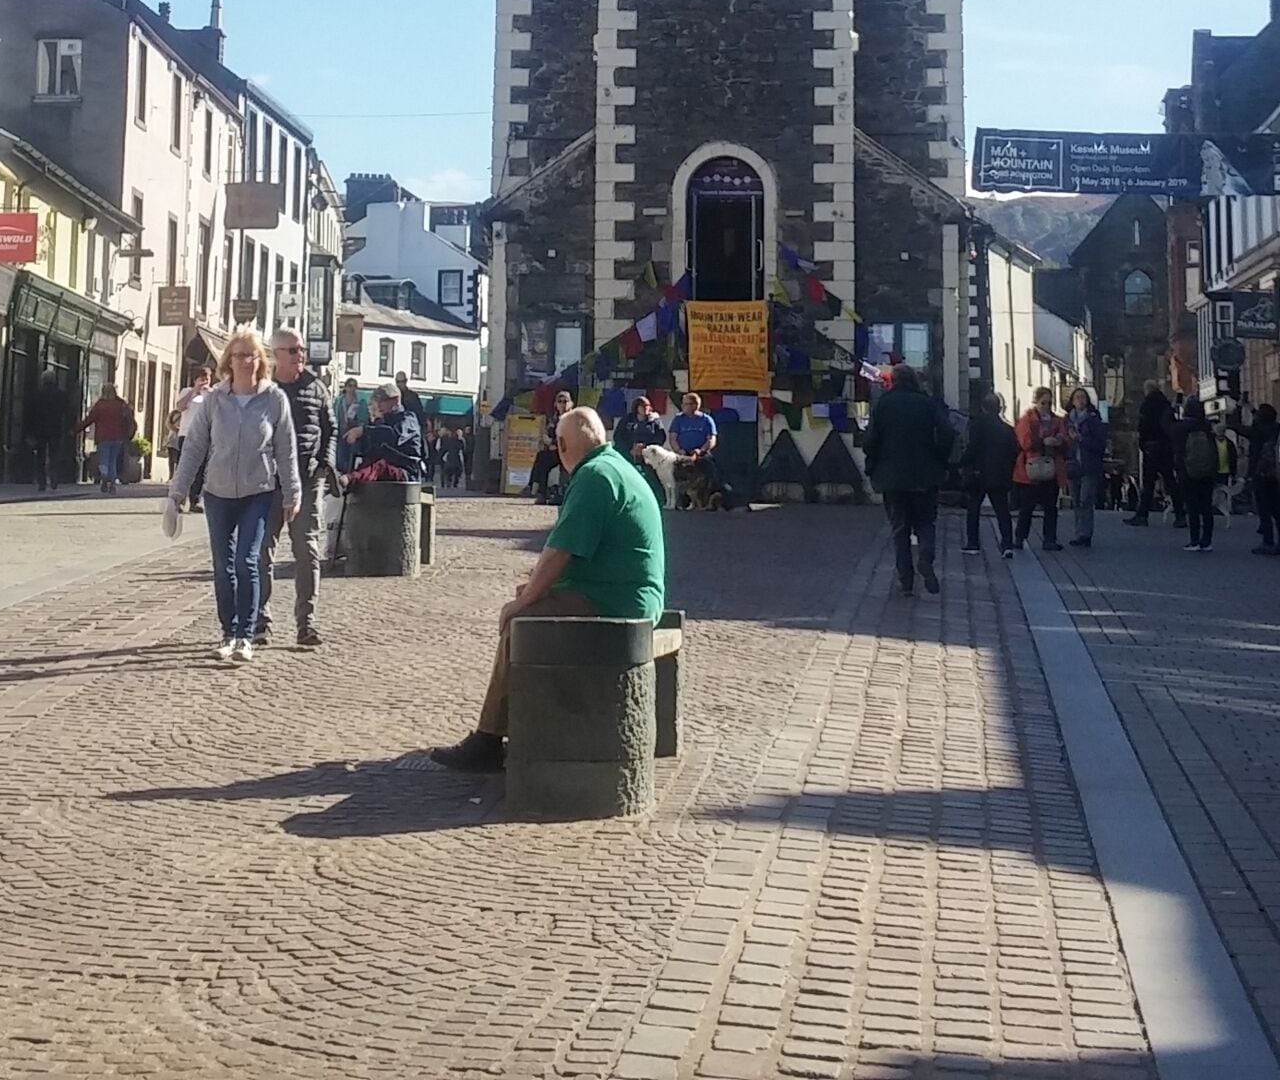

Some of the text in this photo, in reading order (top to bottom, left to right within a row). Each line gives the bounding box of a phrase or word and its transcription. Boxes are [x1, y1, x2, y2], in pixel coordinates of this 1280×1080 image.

[990, 145, 1018, 158] MAN
[1110, 143, 1151, 155] Museum
[990, 157, 1054, 171] MOUNTAIN
[1071, 164, 1091, 174] Open
[1092, 164, 1111, 174] Daily
[1081, 177, 1099, 187] May
[1100, 177, 1120, 186] 2018
[1127, 178, 1133, 186] 6
[1134, 178, 1166, 188] January
[1168, 178, 1188, 187] 2019
